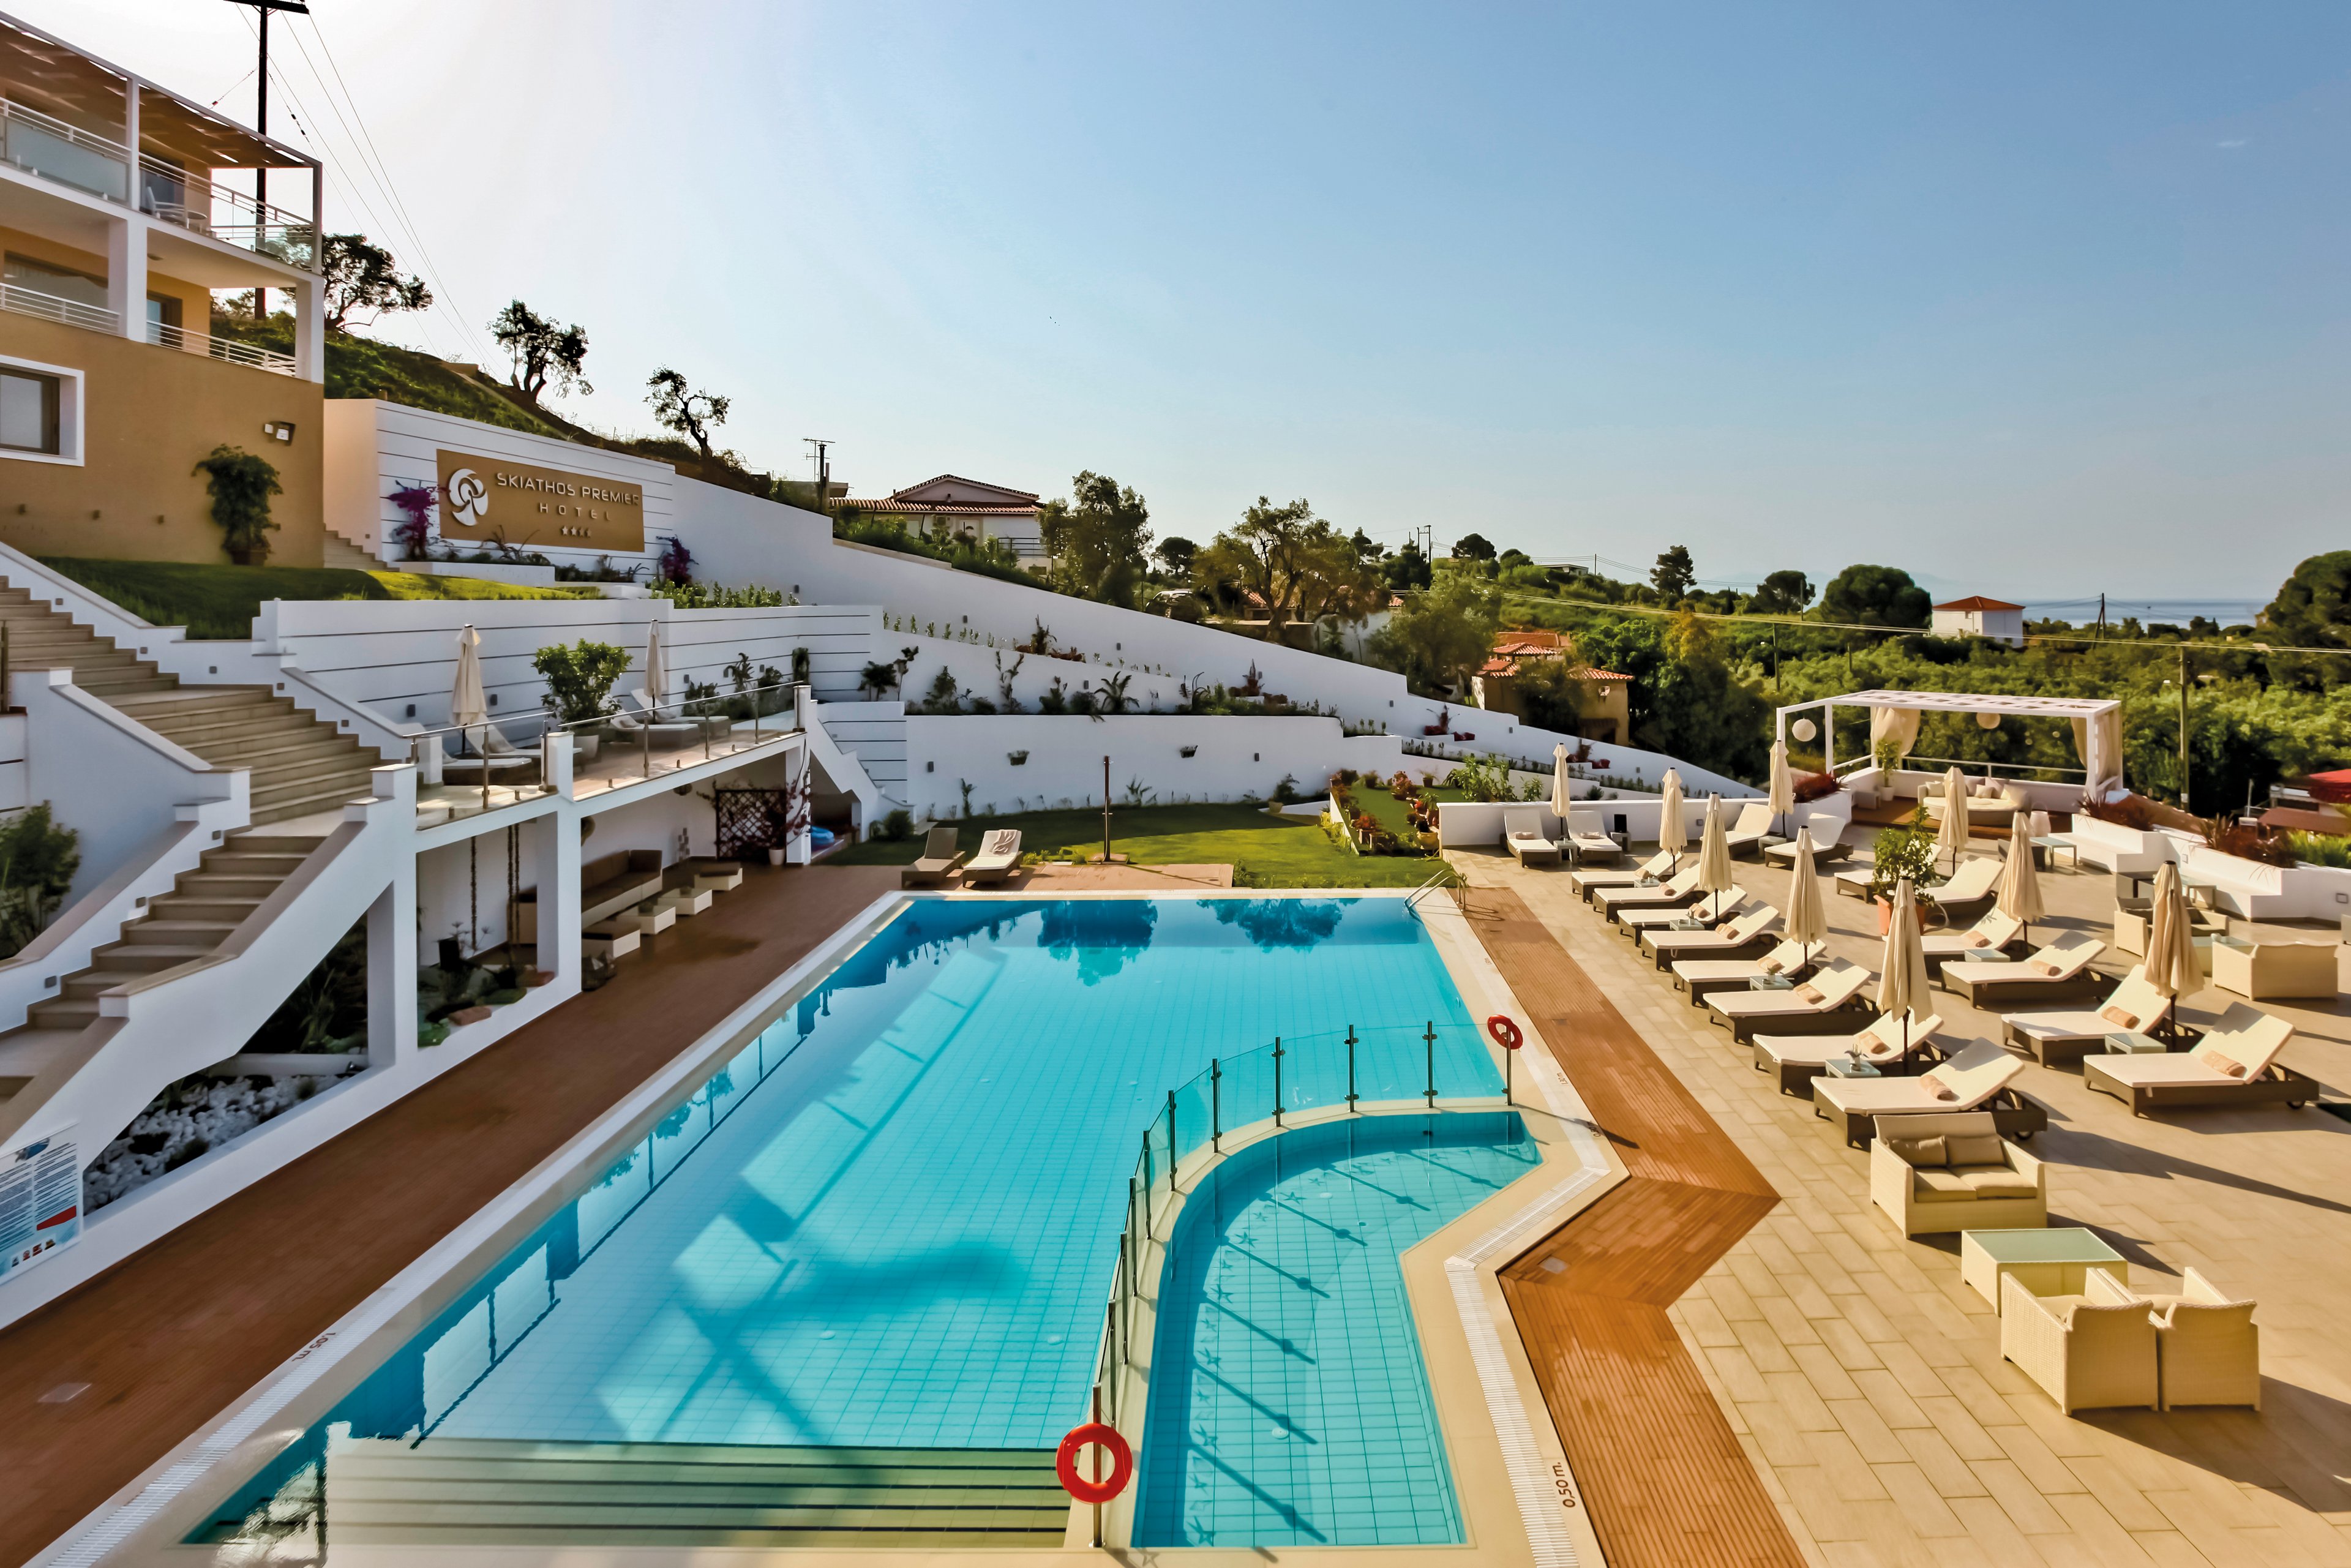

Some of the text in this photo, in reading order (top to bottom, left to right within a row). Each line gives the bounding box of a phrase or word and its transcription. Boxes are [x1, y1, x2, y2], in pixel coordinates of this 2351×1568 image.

[497, 473, 639, 506] SKIATHOS PREMIER
[1552, 1462, 1576, 1508] 0,50 m.
